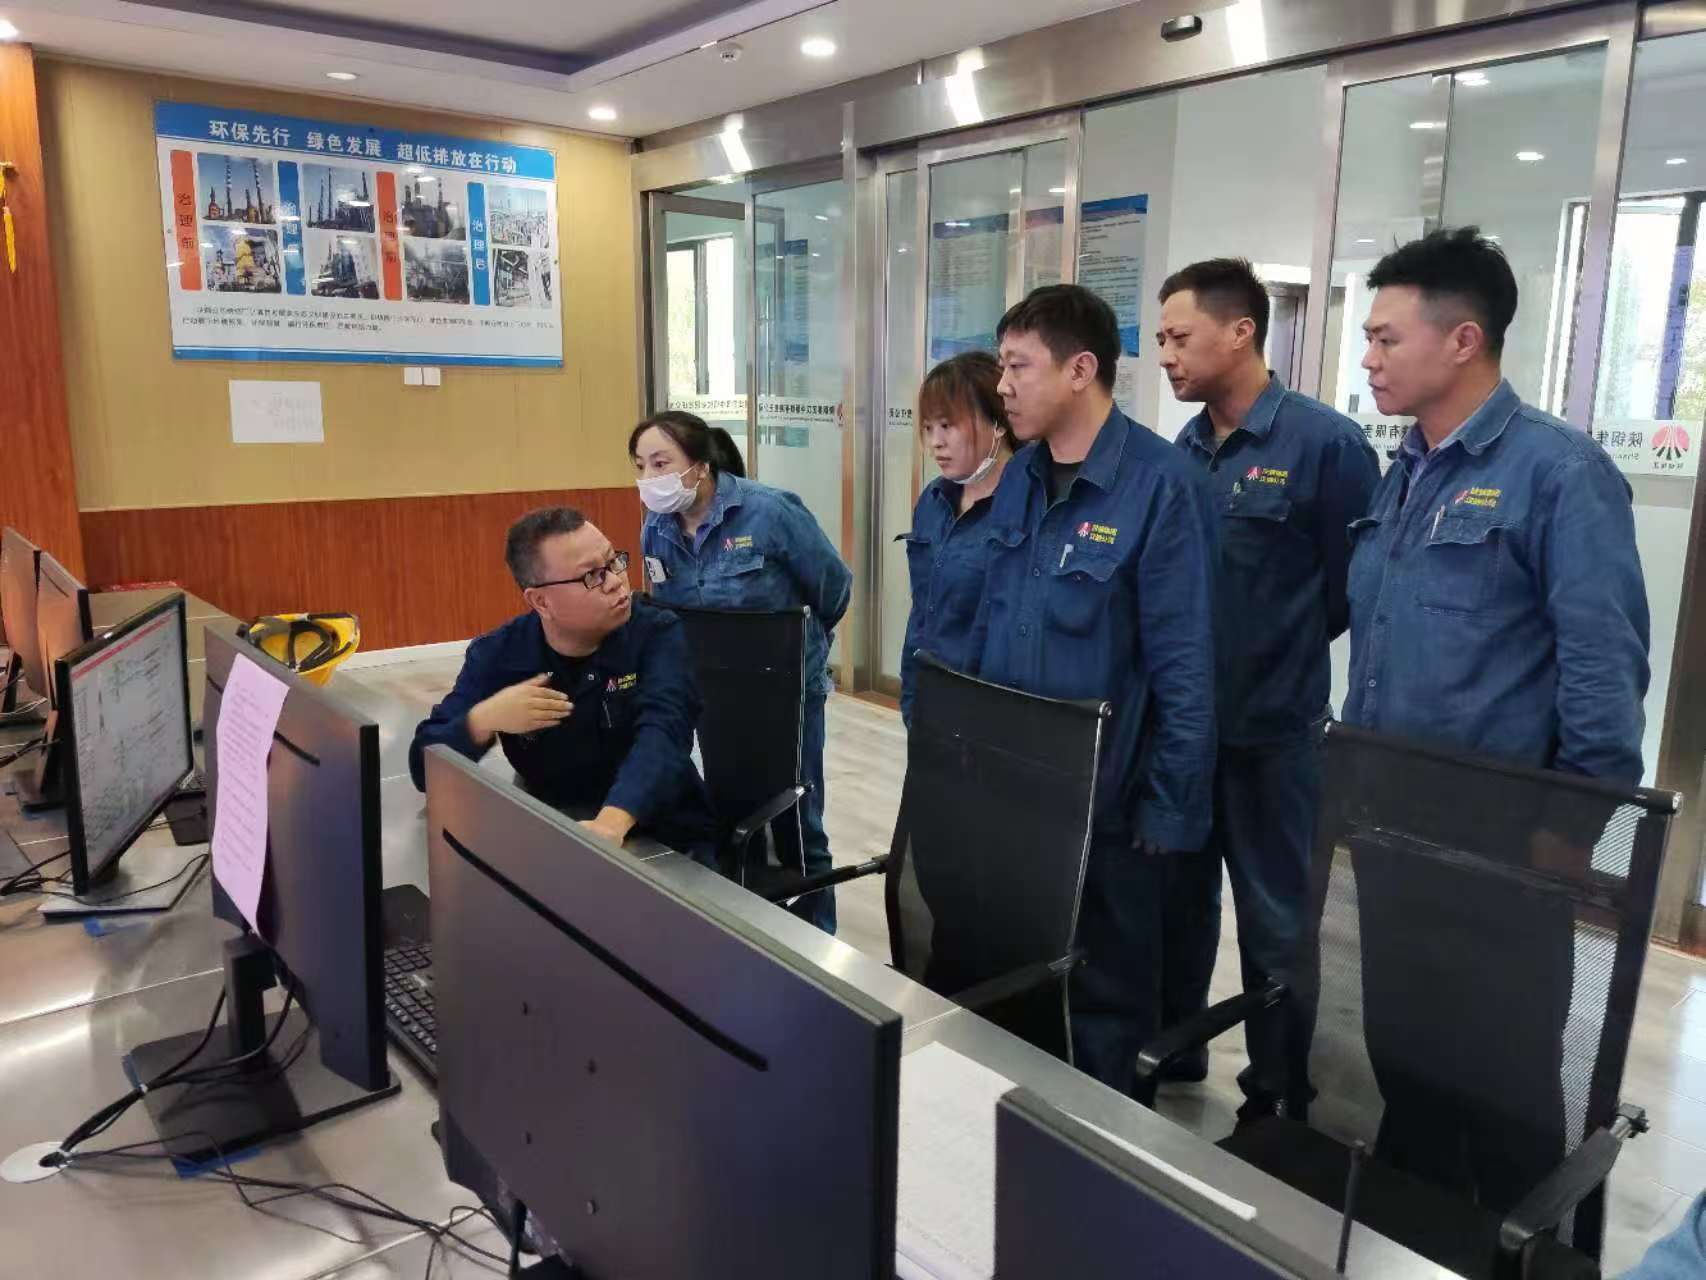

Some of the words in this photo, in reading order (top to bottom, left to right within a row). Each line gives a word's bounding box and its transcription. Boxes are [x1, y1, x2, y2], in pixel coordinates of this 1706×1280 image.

[208, 120, 291, 147] 环保先行
[306, 131, 383, 158] 绿色发展
[396, 142, 518, 174] 超低排放在行动
